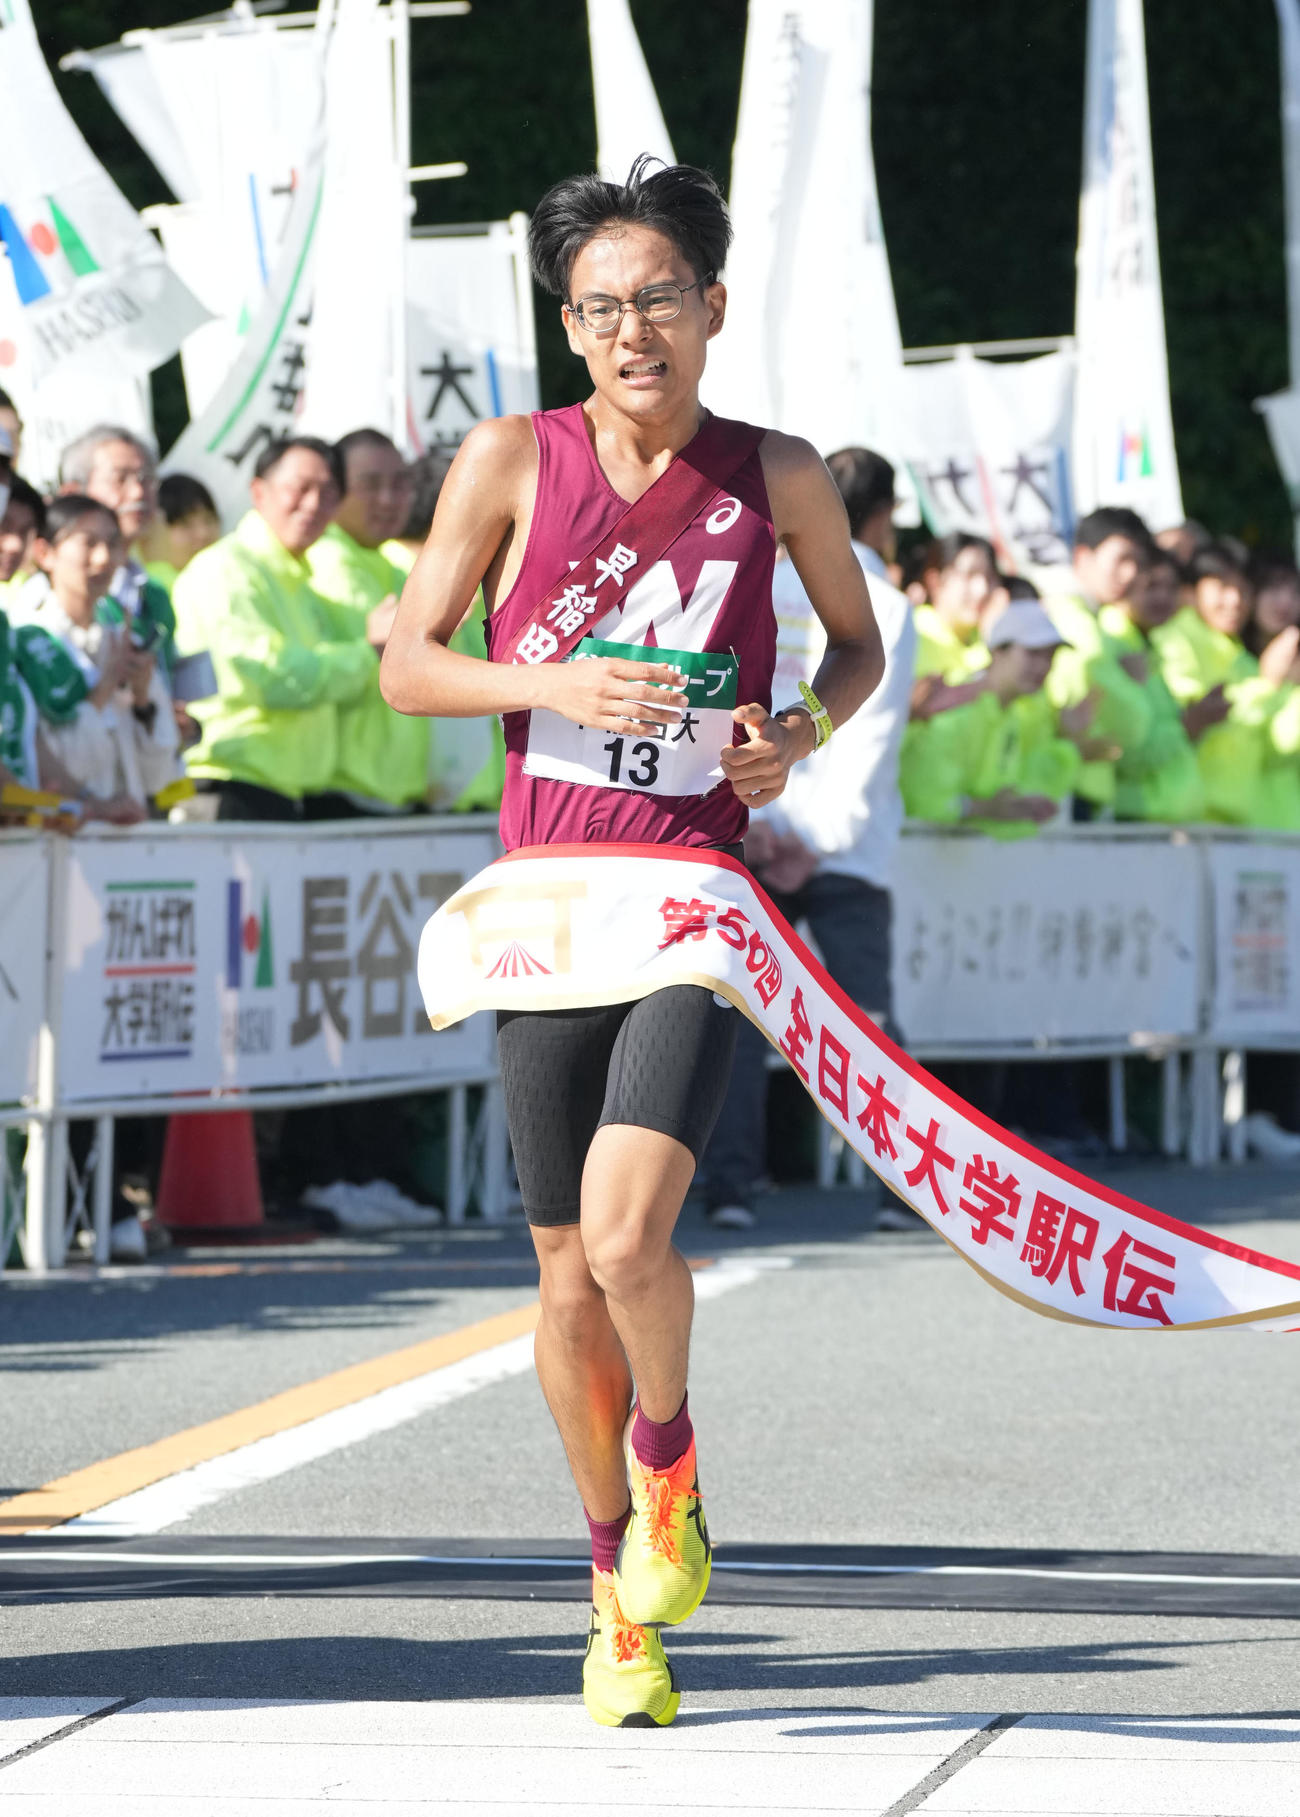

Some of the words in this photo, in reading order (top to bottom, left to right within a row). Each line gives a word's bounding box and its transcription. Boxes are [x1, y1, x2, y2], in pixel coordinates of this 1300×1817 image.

[603, 737, 660, 787] 13
[779, 985, 1177, 1326] 全日本大学駅伝
